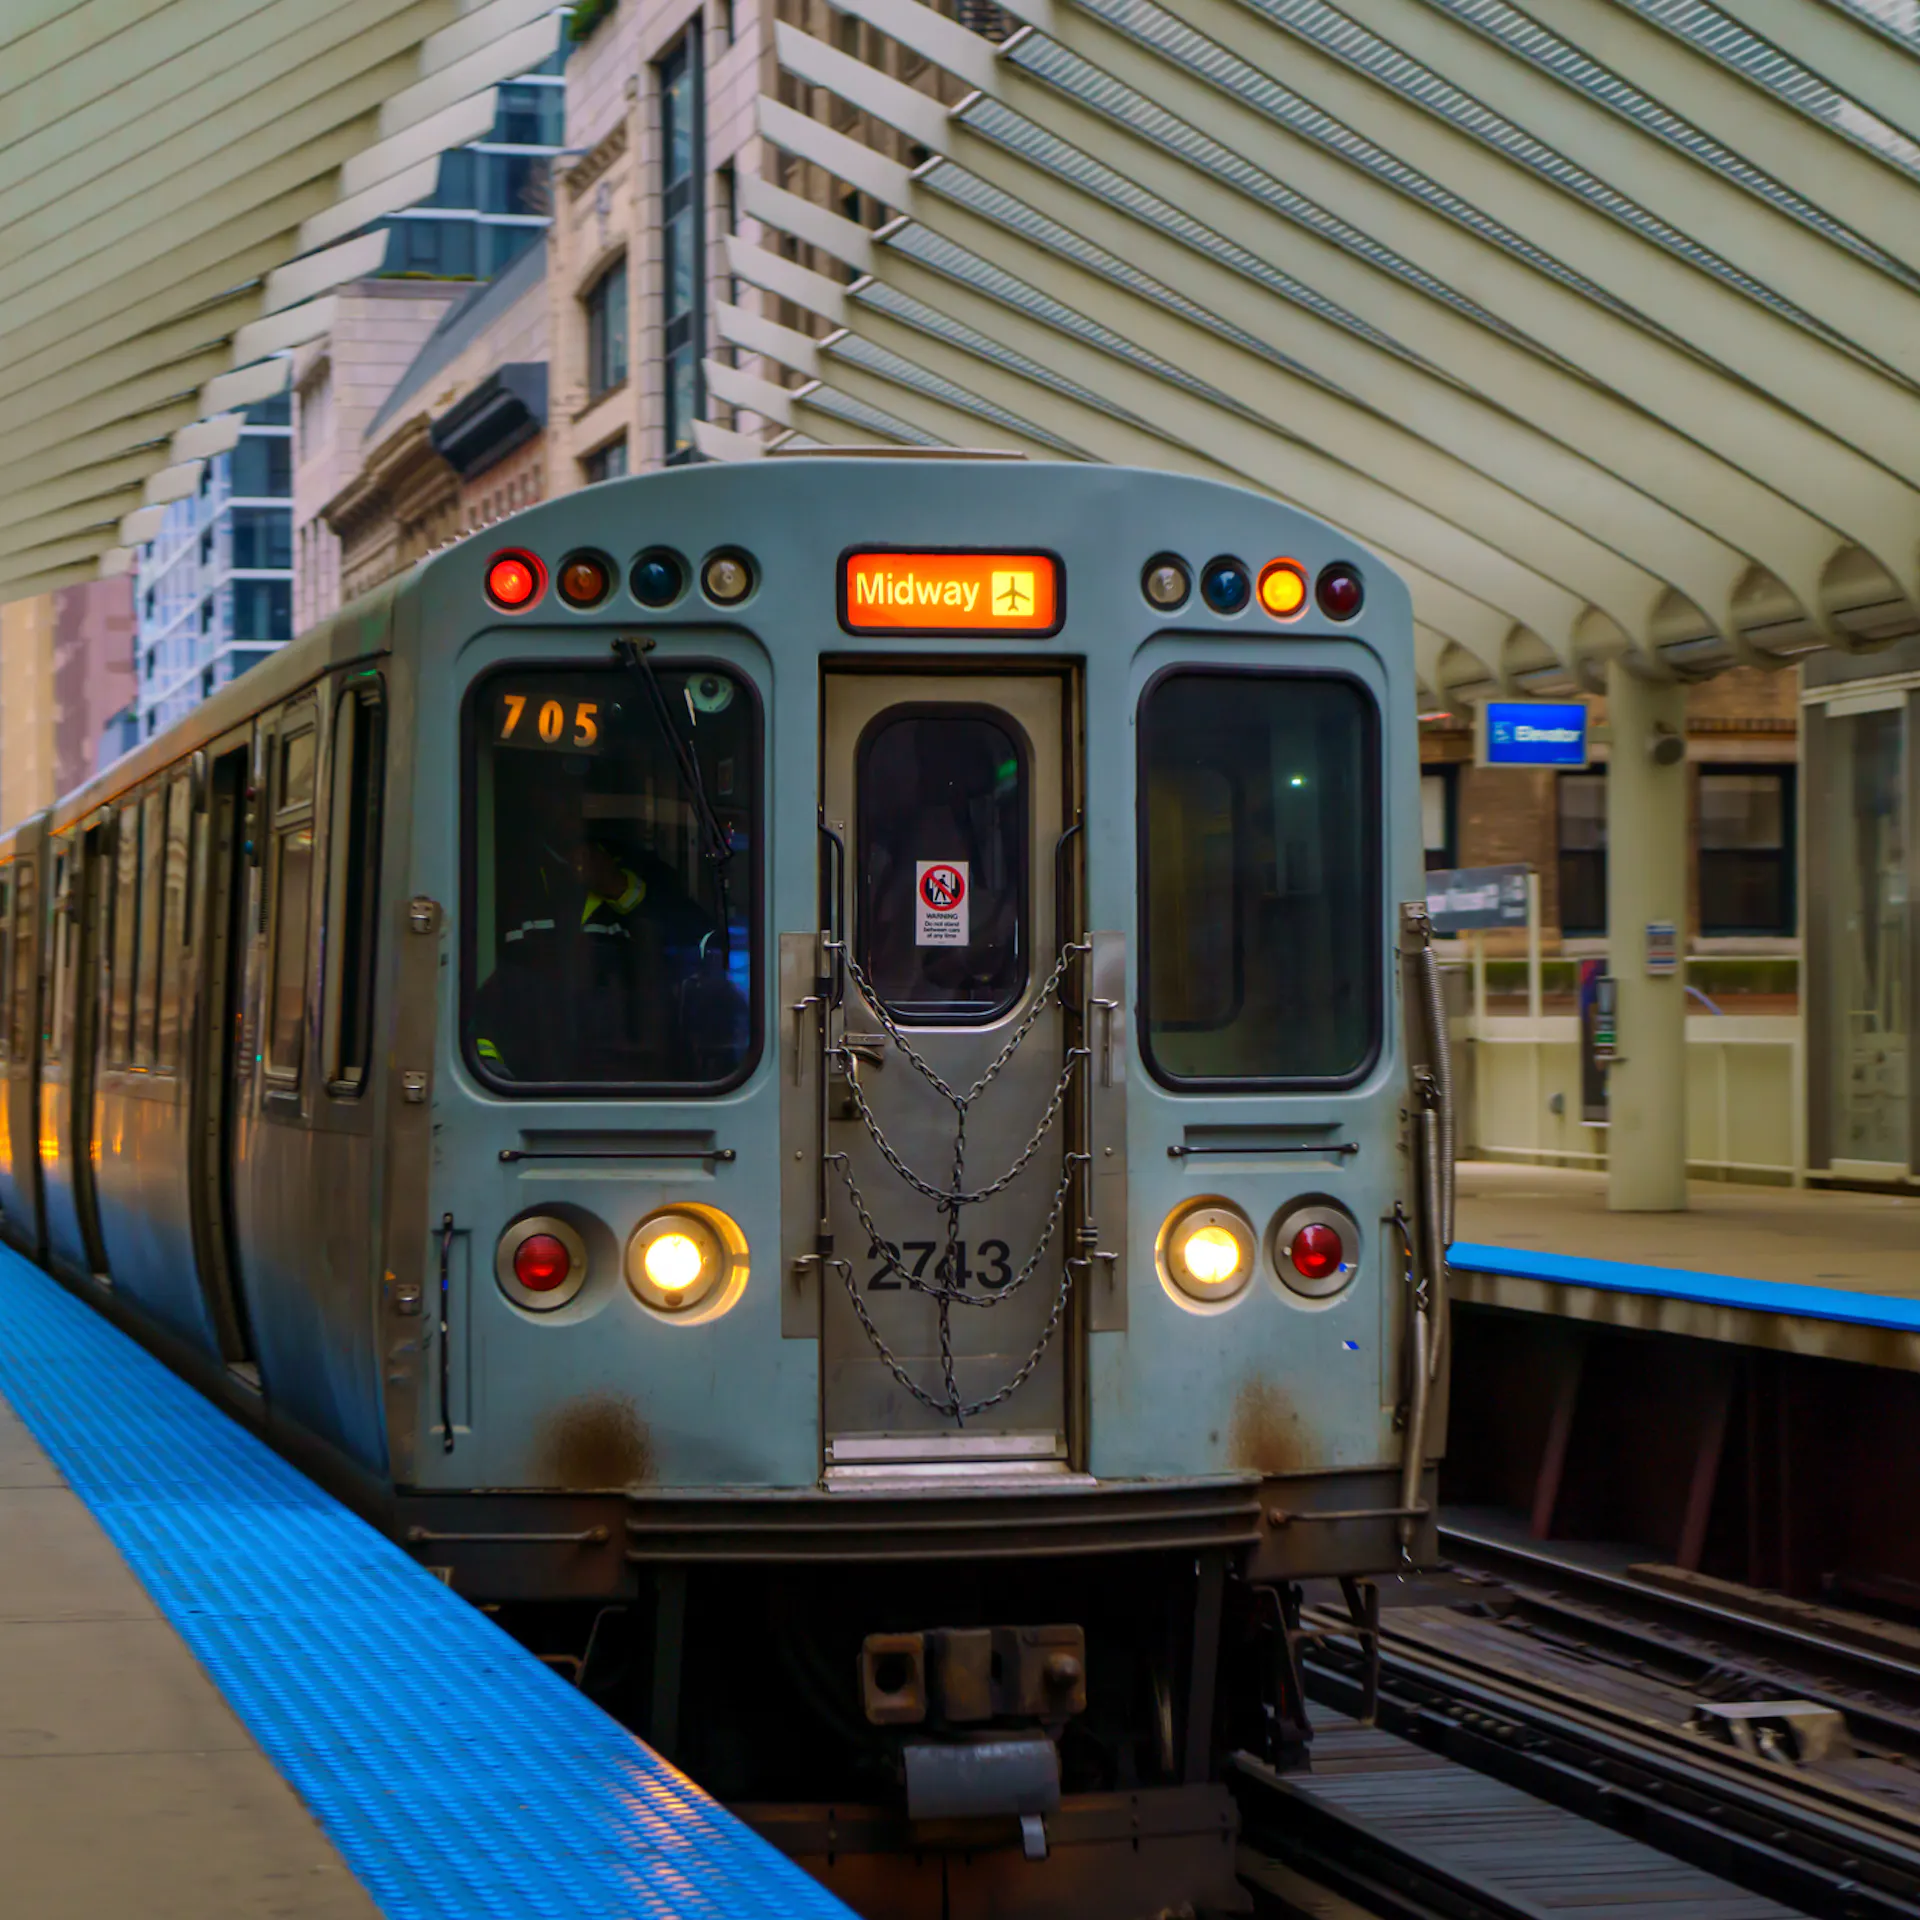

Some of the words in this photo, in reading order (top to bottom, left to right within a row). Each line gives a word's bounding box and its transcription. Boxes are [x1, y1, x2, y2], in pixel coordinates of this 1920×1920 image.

[856, 572, 980, 612] Midway
[501, 694, 598, 747] 705
[867, 1240, 1012, 1290] 2743
